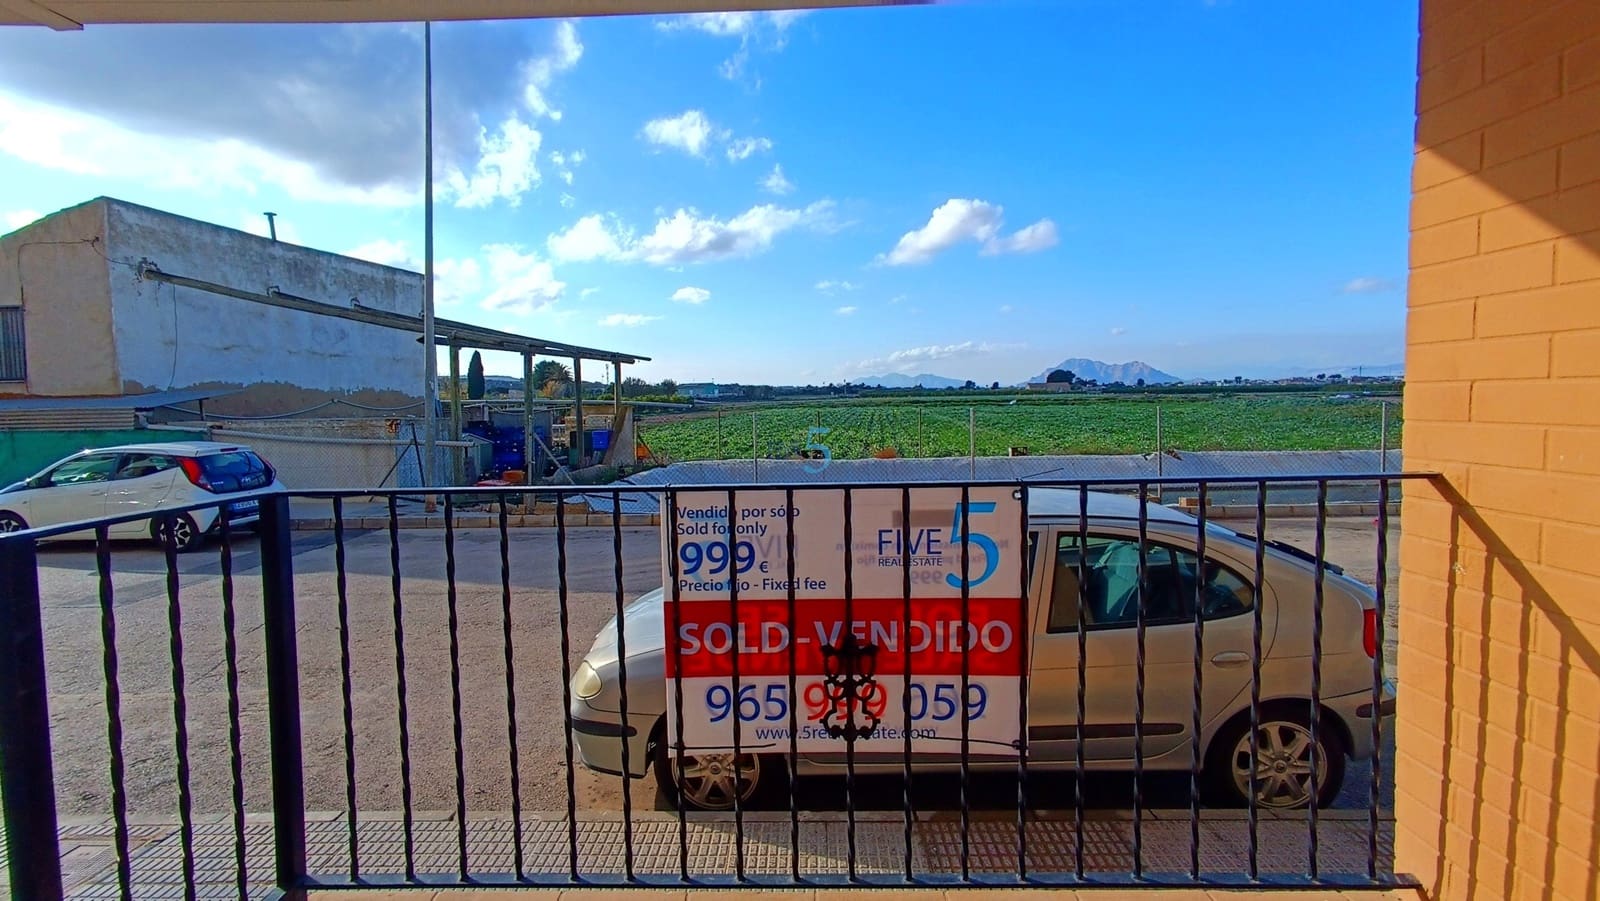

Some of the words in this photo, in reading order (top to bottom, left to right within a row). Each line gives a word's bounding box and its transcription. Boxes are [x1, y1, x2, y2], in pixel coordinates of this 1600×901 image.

[677, 504, 737, 519] Vendid
[742, 507, 766, 520] por
[770, 504, 800, 518] sóo
[677, 522, 708, 535] Sold
[736, 521, 767, 537] only
[878, 528, 942, 555] FIVE
[945, 502, 1000, 589] 5
[679, 579, 724, 591] Precio
[728, 578, 750, 594] fjo
[762, 577, 800, 591] Fixed
[805, 577, 827, 590] fee
[706, 684, 788, 722] 965
[903, 683, 988, 722] 059
